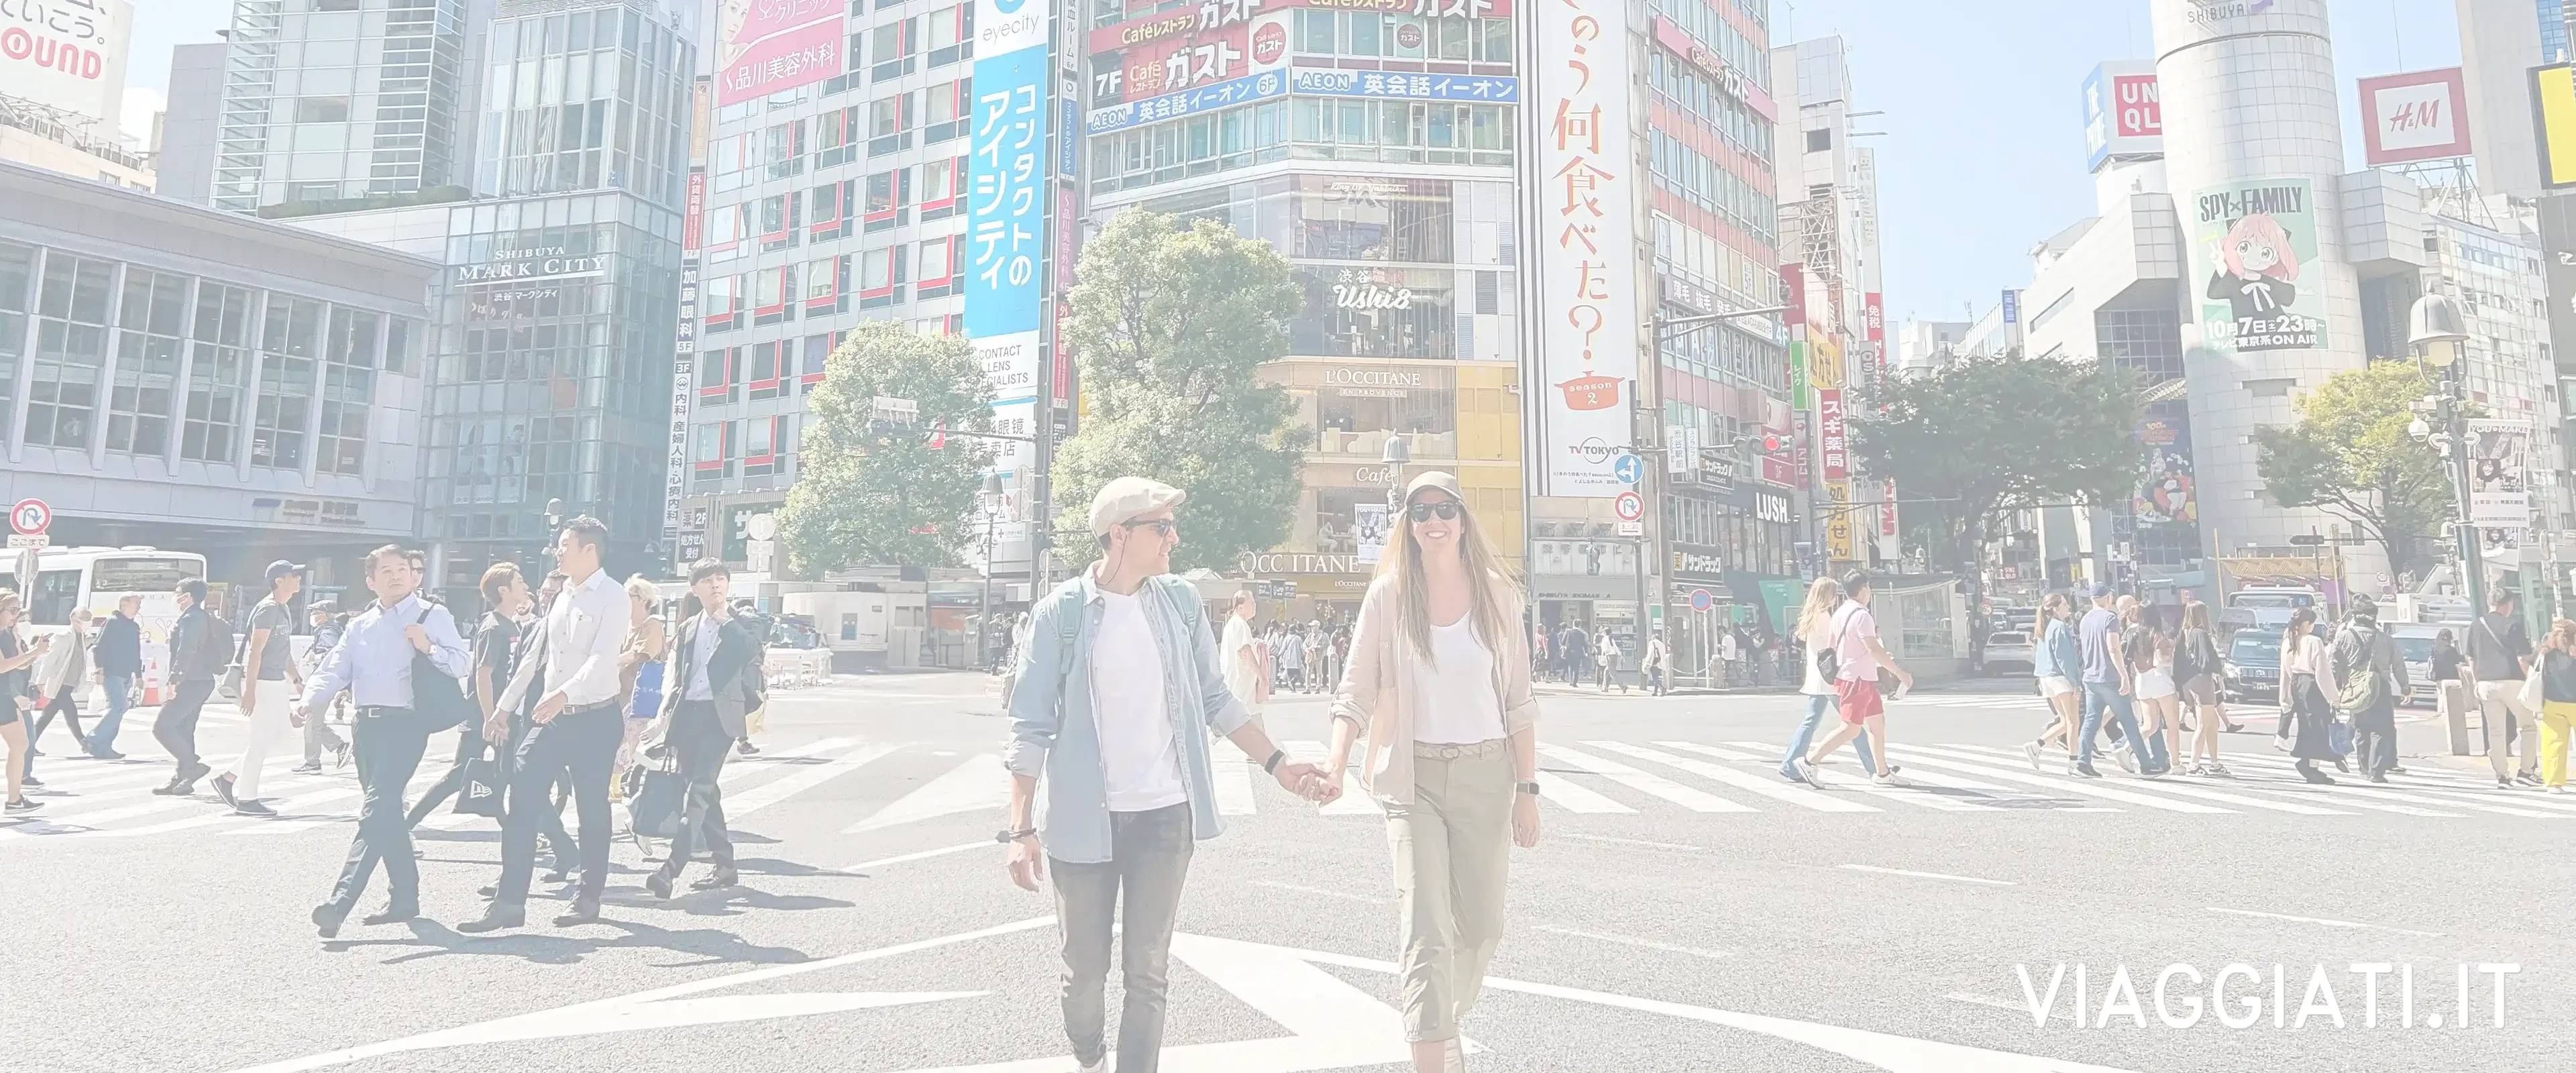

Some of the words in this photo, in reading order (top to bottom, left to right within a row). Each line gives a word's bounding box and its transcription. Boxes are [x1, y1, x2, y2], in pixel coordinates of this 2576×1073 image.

[1199, 0, 1262, 34] ガスト
[2188, 3, 2245, 23] SHIBUYA
[983, 13, 1039, 45] eyecity
[1256, 39, 1283, 55] ガスト
[735, 40, 835, 92] 品川美容外科
[1129, 60, 1162, 80] Café
[1164, 40, 1242, 91] ガスト
[1095, 69, 1122, 97] 7F
[1299, 72, 1352, 91] AEON
[1091, 108, 1128, 131] AEON
[1258, 77, 1278, 93] 6F
[2389, 99, 2440, 133] H&M
[975, 89, 1011, 290] アイシティ
[1008, 84, 1036, 286] コンタクトの
[1549, 0, 1616, 360] のう何食べた？
[494, 245, 565, 260] SHIBUYA
[458, 262, 533, 281] MARK
[543, 254, 607, 274] CITY
[1338, 268, 1370, 284] 渋谷
[679, 270, 698, 337] 加藤眼科
[1868, 304, 1881, 329] 免税
[678, 343, 692, 351] 5F
[979, 344, 1022, 360] CONTACT
[2212, 335, 2271, 350] テレビ東京系
[2272, 334, 2294, 345] ON
[2296, 333, 2319, 345] AIR
[677, 363, 690, 373] 3F
[987, 360, 1011, 373] LENS
[1793, 363, 1801, 386] レイク
[1568, 381, 1612, 393] season
[674, 392, 688, 416] 内科
[1587, 392, 1599, 406] 2
[1823, 400, 1844, 468] スギ薬局
[1568, 445, 1582, 454] TV
[1583, 446, 1619, 455] TOKYO
[1756, 492, 1788, 524] LUSH
[1829, 486, 1849, 557] 処方せん
[680, 534, 705, 546] 処方せん
[685, 547, 700, 559] 受付
[1687, 554, 1721, 573] サンドラッグ
